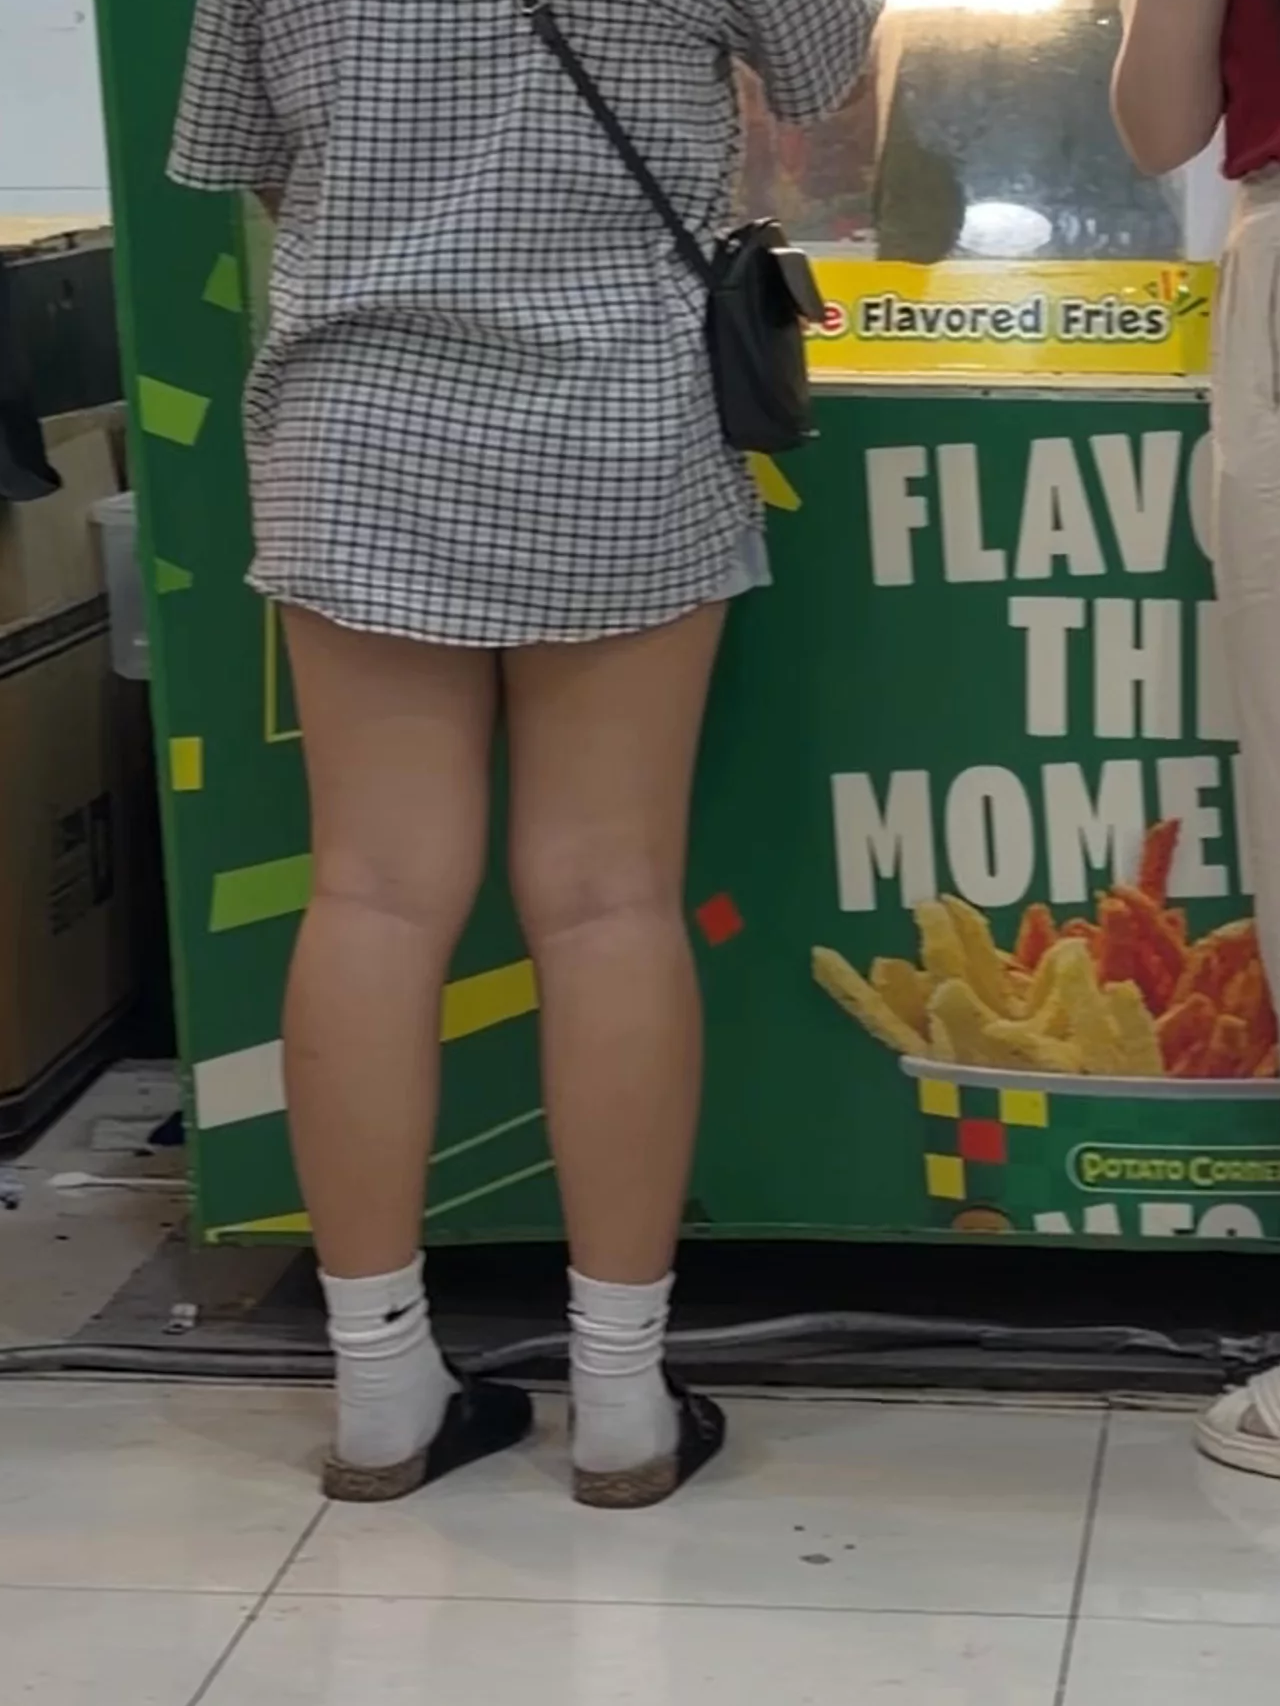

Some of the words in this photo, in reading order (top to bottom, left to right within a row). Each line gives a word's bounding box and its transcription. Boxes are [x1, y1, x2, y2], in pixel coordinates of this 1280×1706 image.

[861, 297, 1042, 335] Flavored
[1062, 299, 1164, 336] Fries
[830, 754, 1254, 912] MOME
